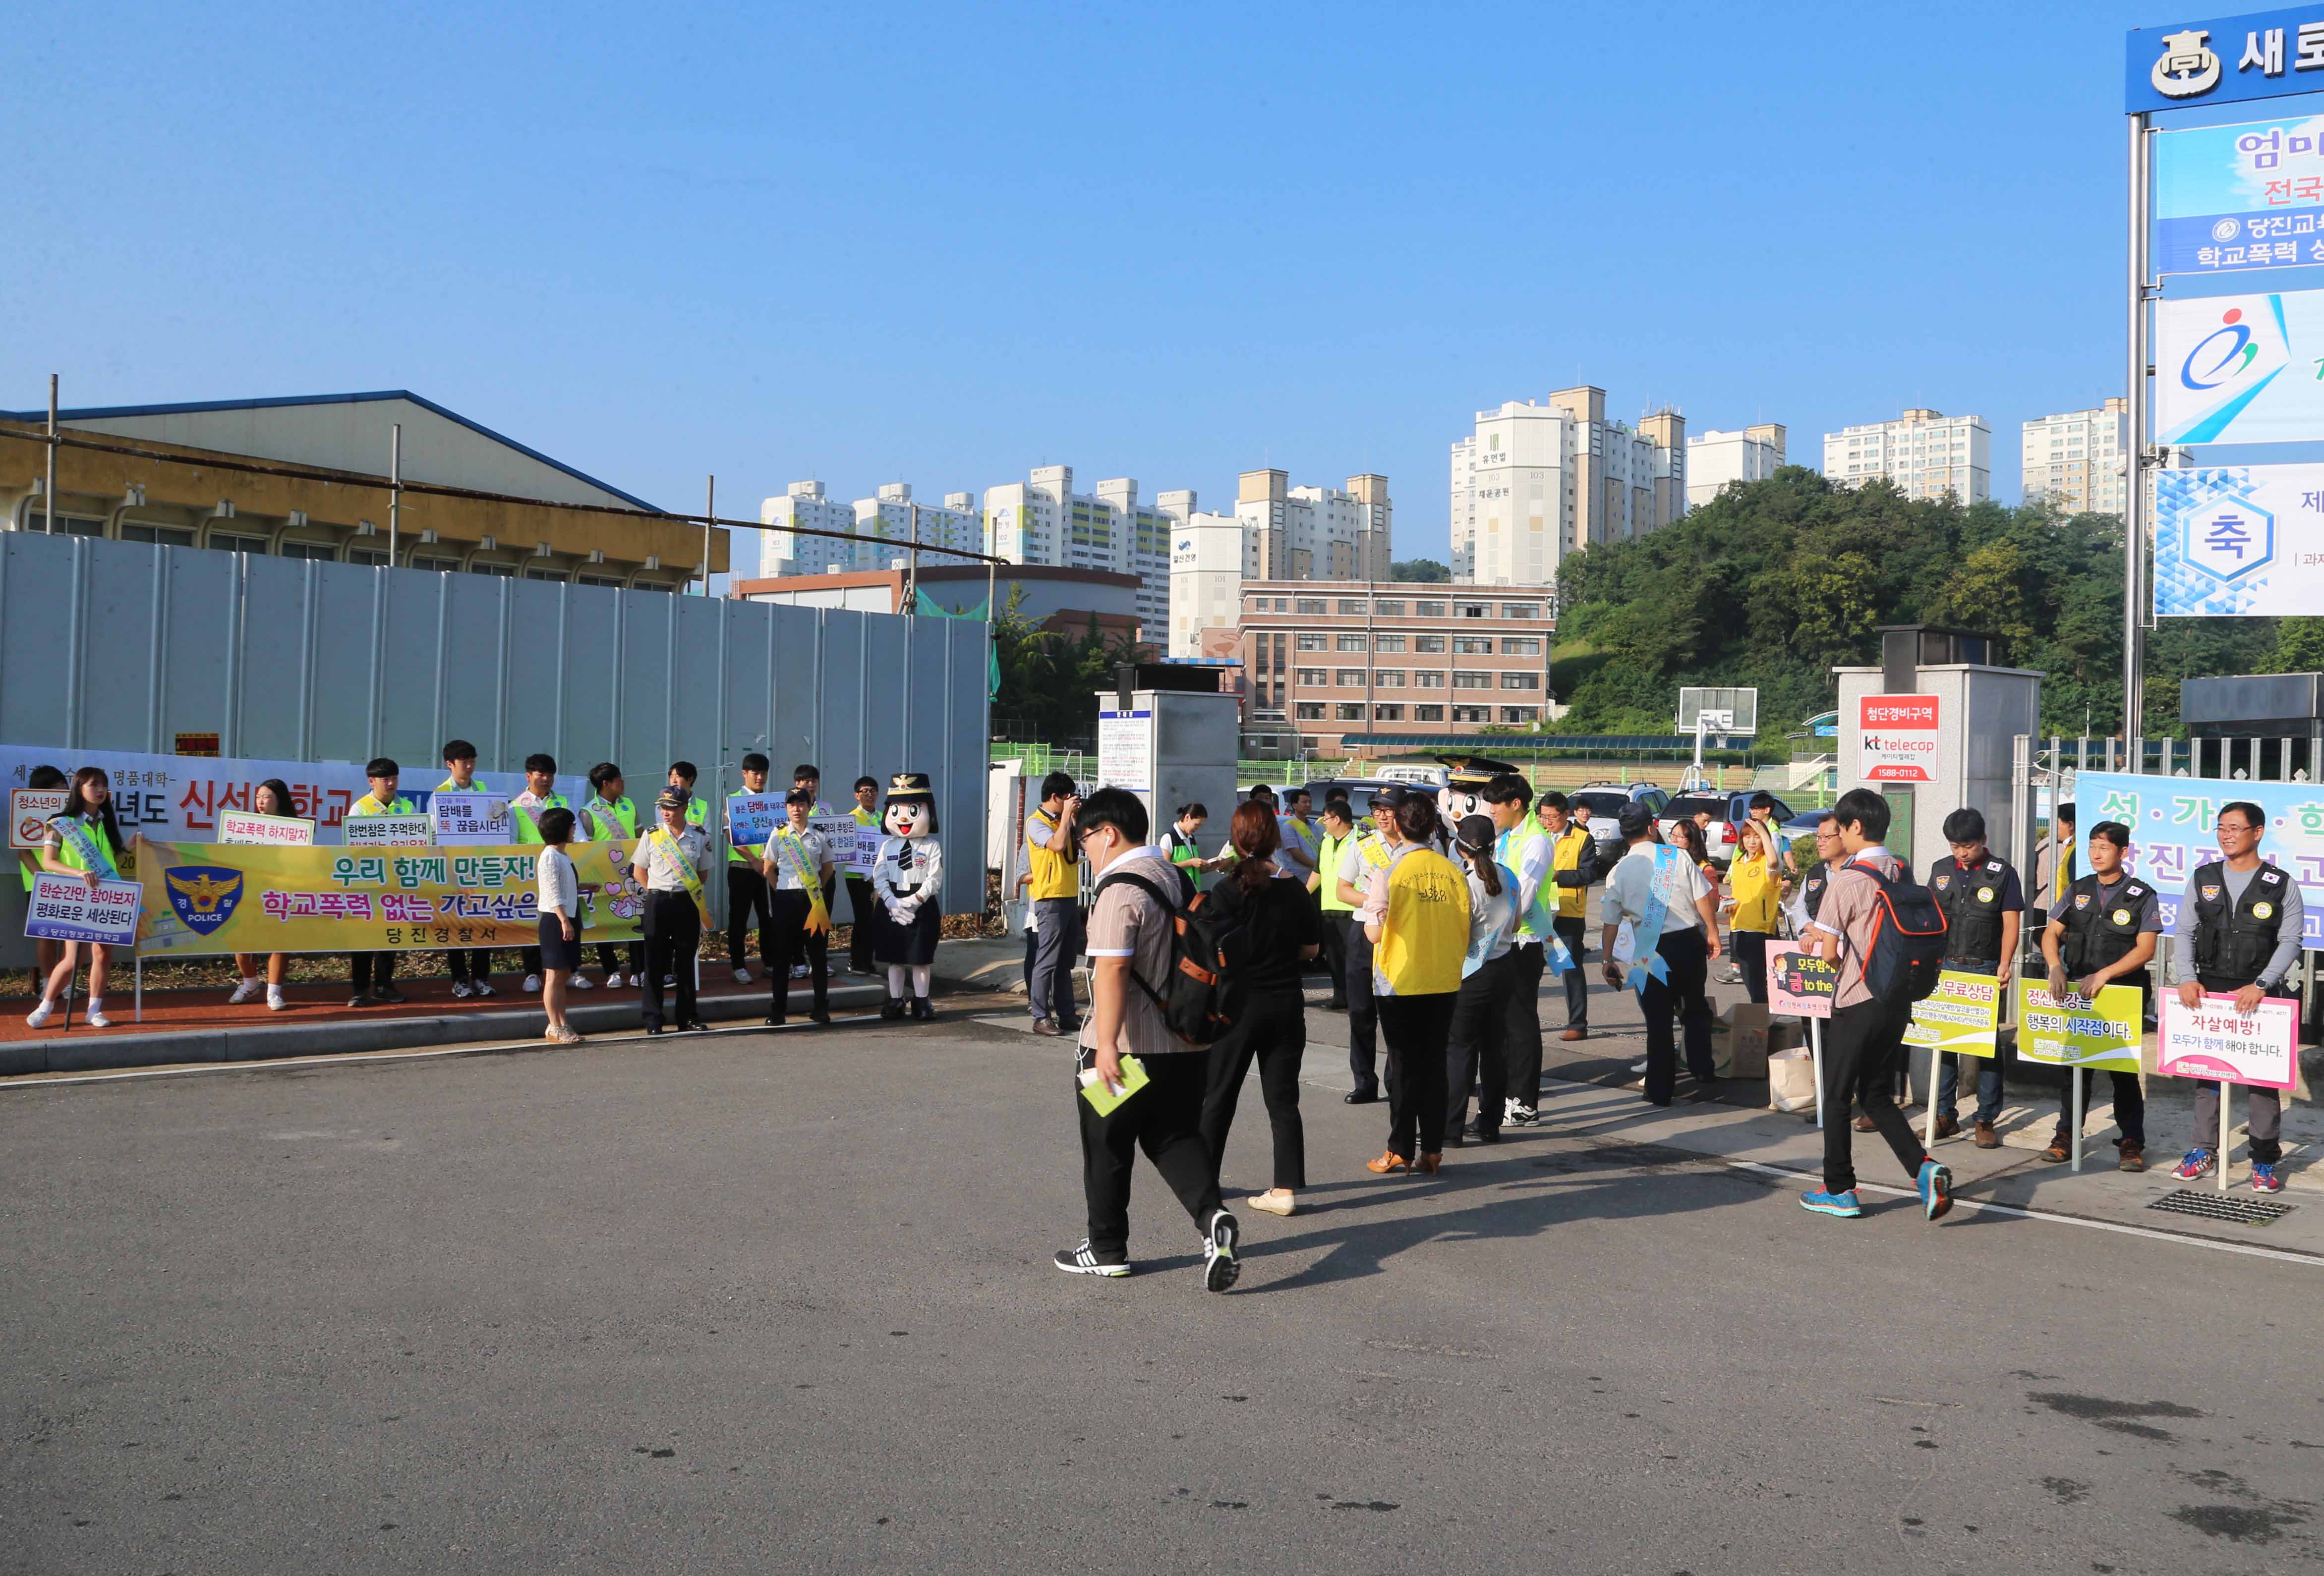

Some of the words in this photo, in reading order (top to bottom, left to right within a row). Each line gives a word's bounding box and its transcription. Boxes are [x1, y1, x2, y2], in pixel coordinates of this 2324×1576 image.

[2197, 241, 2297, 268] 학교폭력
[2205, 515, 2251, 559] 축
[1867, 707, 1933, 721] 첨단경비구역
[1864, 736, 1881, 750] kt
[1884, 737, 1934, 754] telecop
[1878, 769, 1918, 778] 1588-0112
[18, 795, 60, 810] 청소년의
[439, 805, 472, 818] 담배를
[226, 819, 266, 838] 학교폭력
[269, 824, 309, 842] 하지말자
[349, 823, 387, 838] 한번참은
[389, 822, 427, 836] 주먹한대
[440, 820, 452, 833] 뚝
[457, 819, 504, 833] 끊읍시다.
[837, 821, 854, 833] 추방은
[333, 857, 386, 887] 우리
[393, 857, 446, 888] 함께
[454, 855, 535, 887] 만들자!
[39, 882, 87, 902] 한순간만
[90, 888, 136, 907] 참아보자
[177, 899, 187, 908] 경
[1425, 888, 1447, 902] 1388
[36, 902, 83, 922] 평화로운
[86, 907, 133, 926] 세상된다
[262, 891, 371, 921] 학교폭력
[380, 894, 433, 921] 없는
[440, 892, 538, 920] 가고싶은
[188, 913, 222, 922] POLICE
[50, 928, 120, 942] 당진정보고등학교
[1789, 972, 1803, 992] 금
[1804, 979, 1815, 991] to
[1816, 979, 1833, 992] the
[1943, 980, 1994, 1002] 무료상담
[2027, 1014, 2062, 1033] 행복의
[2065, 1017, 2132, 1039] 시작점이다.
[2191, 1015, 2262, 1036] 자살예방!
[2172, 1033, 2202, 1048] 모두가
[2204, 1036, 2224, 1051] 함께
[2225, 1040, 2247, 1054] 해야
[2249, 1042, 2283, 1058] 합니다.
